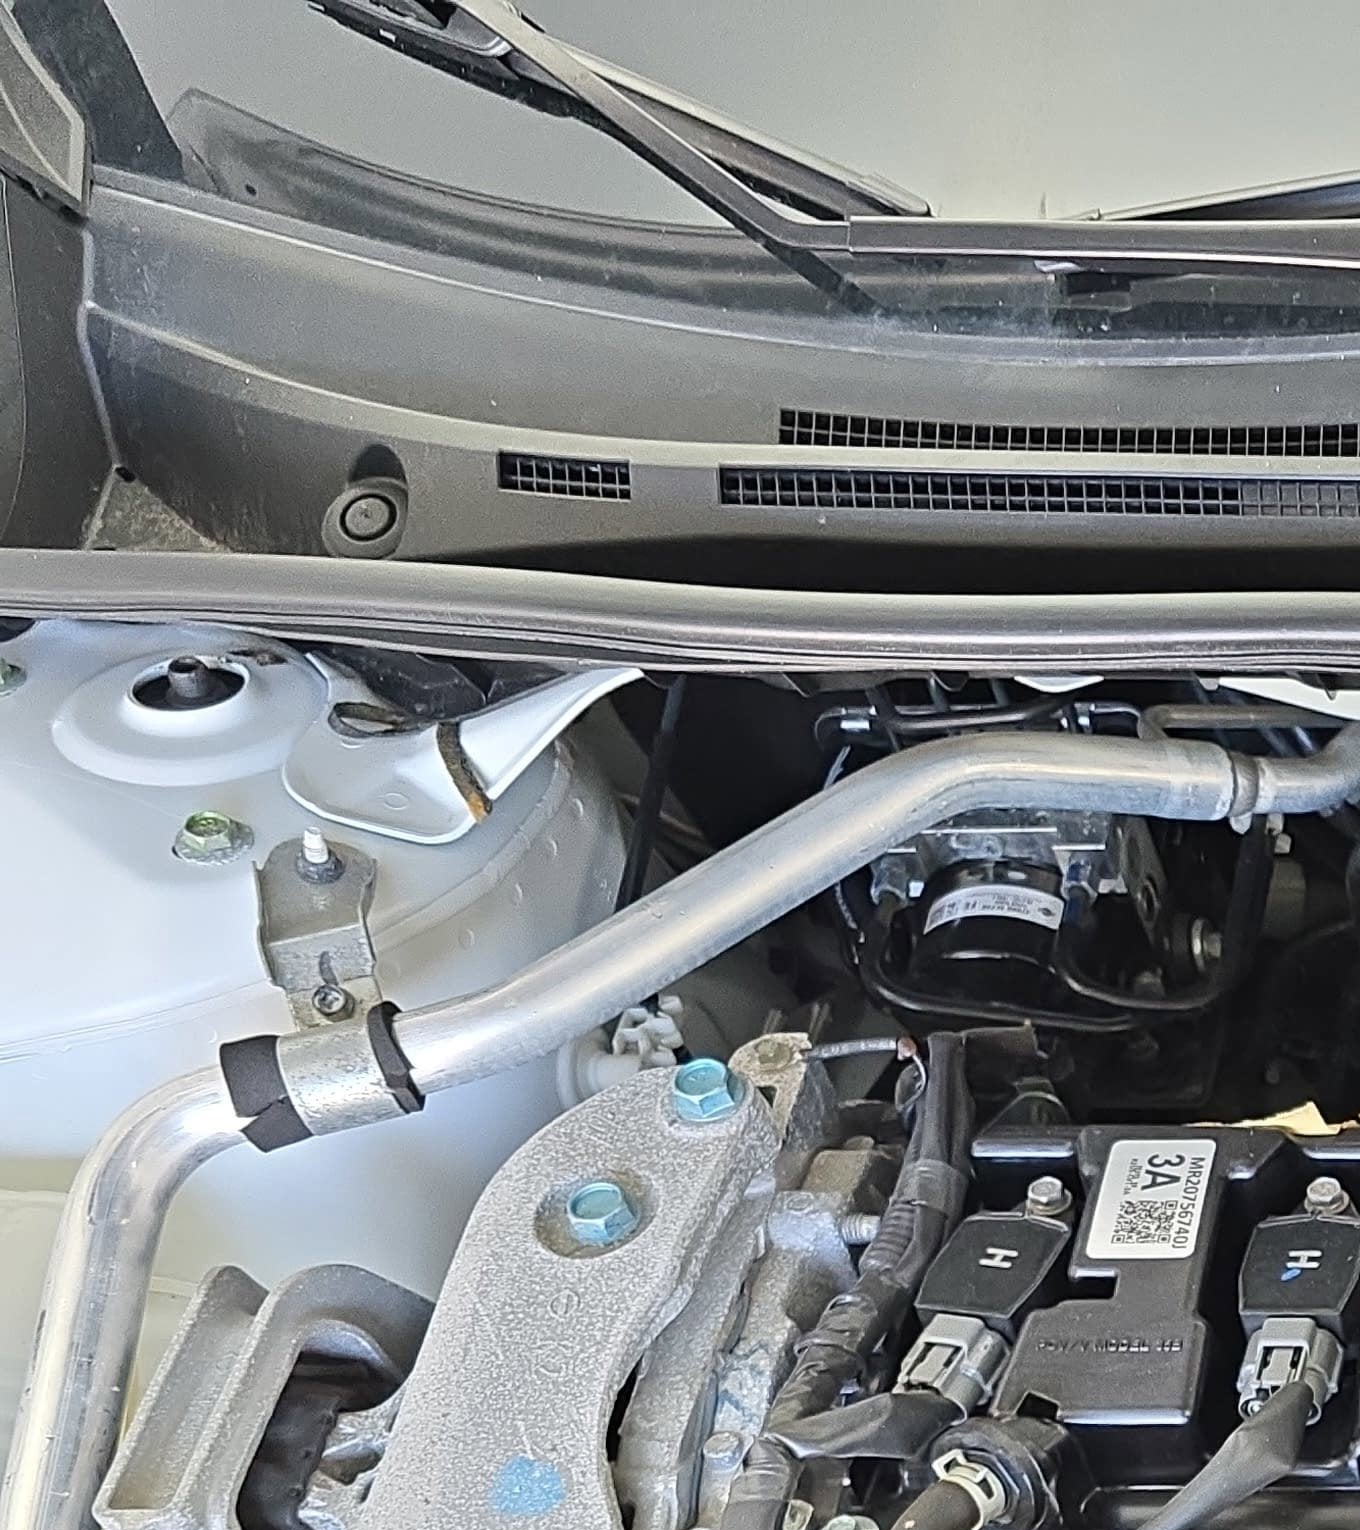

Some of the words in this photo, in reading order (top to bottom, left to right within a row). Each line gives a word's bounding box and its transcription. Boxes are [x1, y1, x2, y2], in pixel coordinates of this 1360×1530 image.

[1140, 1153, 1186, 1191] 3A
[978, 1248, 1019, 1269] H
[1286, 1250, 1322, 1269] H
